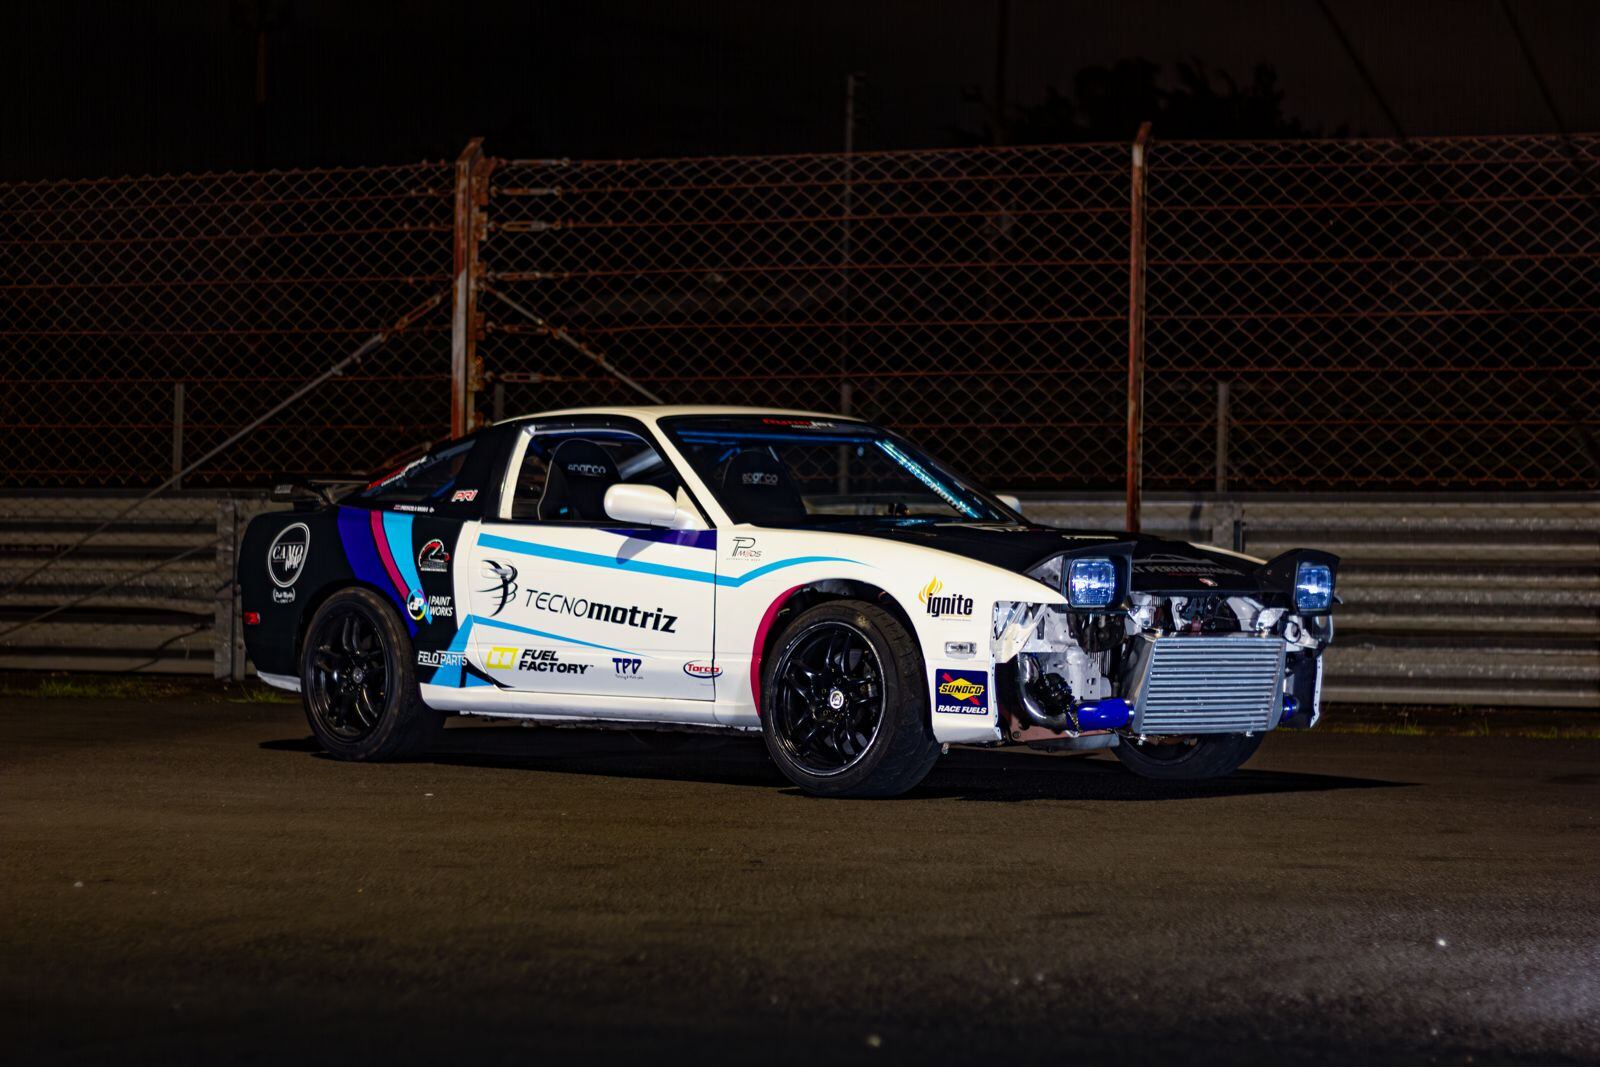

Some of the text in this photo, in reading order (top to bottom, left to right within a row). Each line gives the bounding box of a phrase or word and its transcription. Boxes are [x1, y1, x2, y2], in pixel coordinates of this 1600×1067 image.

[451, 489, 478, 502] PRI
[431, 596, 451, 606] PAINT
[927, 593, 974, 618] ignite
[430, 606, 453, 617] WORKS
[526, 589, 678, 633] TECNOmotriz
[418, 651, 468, 666] FELO PARTS
[521, 649, 559, 662] FUEL
[519, 660, 588, 675] FACTORY
[688, 663, 720, 673] Torco
[941, 684, 983, 695] SUNOCO
[938, 704, 987, 714] RACE FUELS
